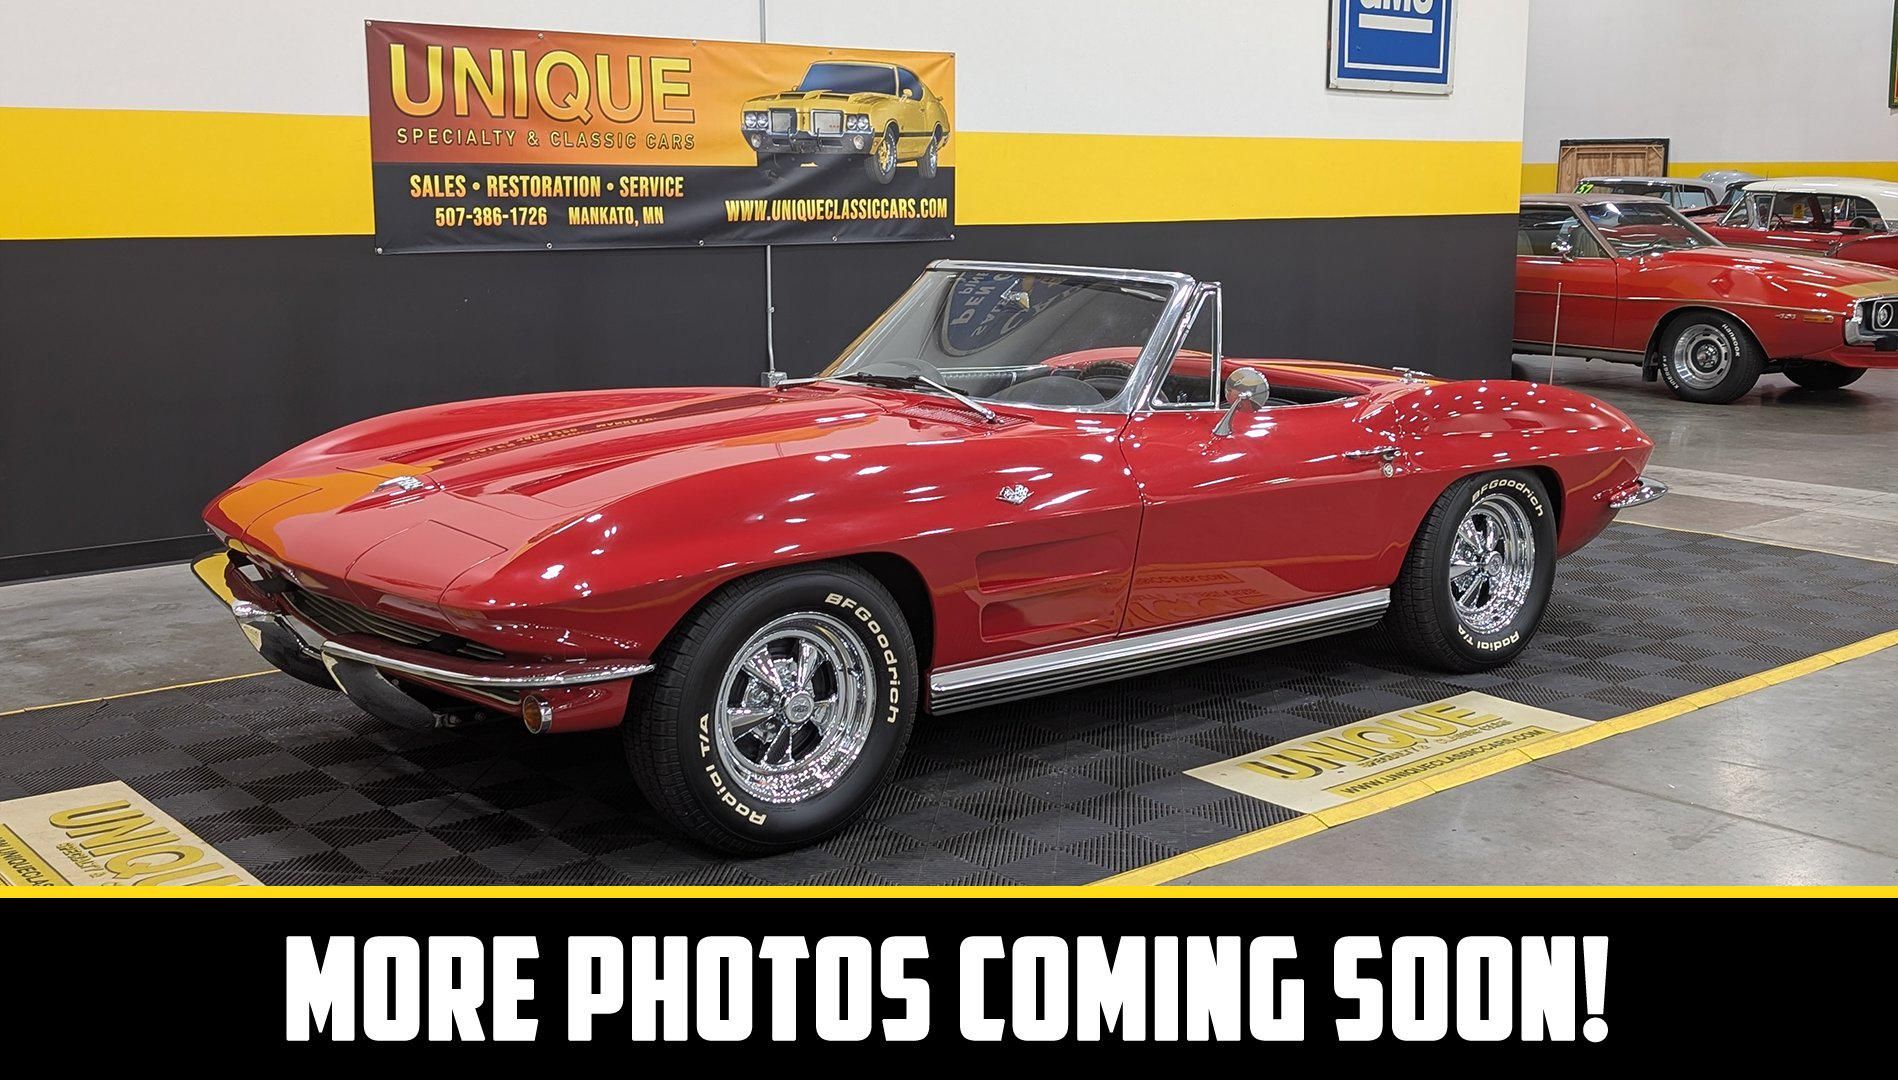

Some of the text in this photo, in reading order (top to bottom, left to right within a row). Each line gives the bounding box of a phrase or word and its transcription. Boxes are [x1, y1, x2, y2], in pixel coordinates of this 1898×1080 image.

[389, 43, 695, 125] UNIQUE
[396, 127, 695, 150] SPECIALTY & CLASSIC CARS
[409, 174, 684, 198] SALES RESTORATION SERVICE
[435, 206, 664, 227] 507-386-1726 MANKATO, MN
[725, 198, 948, 222] WWW.UNIQUECLASSICCARS.COM
[1471, 479, 1544, 517] BFGoodrich
[1477, 631, 1521, 652] Radial
[825, 592, 901, 724] BFGoodrich
[1236, 703, 1504, 781] UNIQUE
[698, 713, 767, 826] Radial T/A
